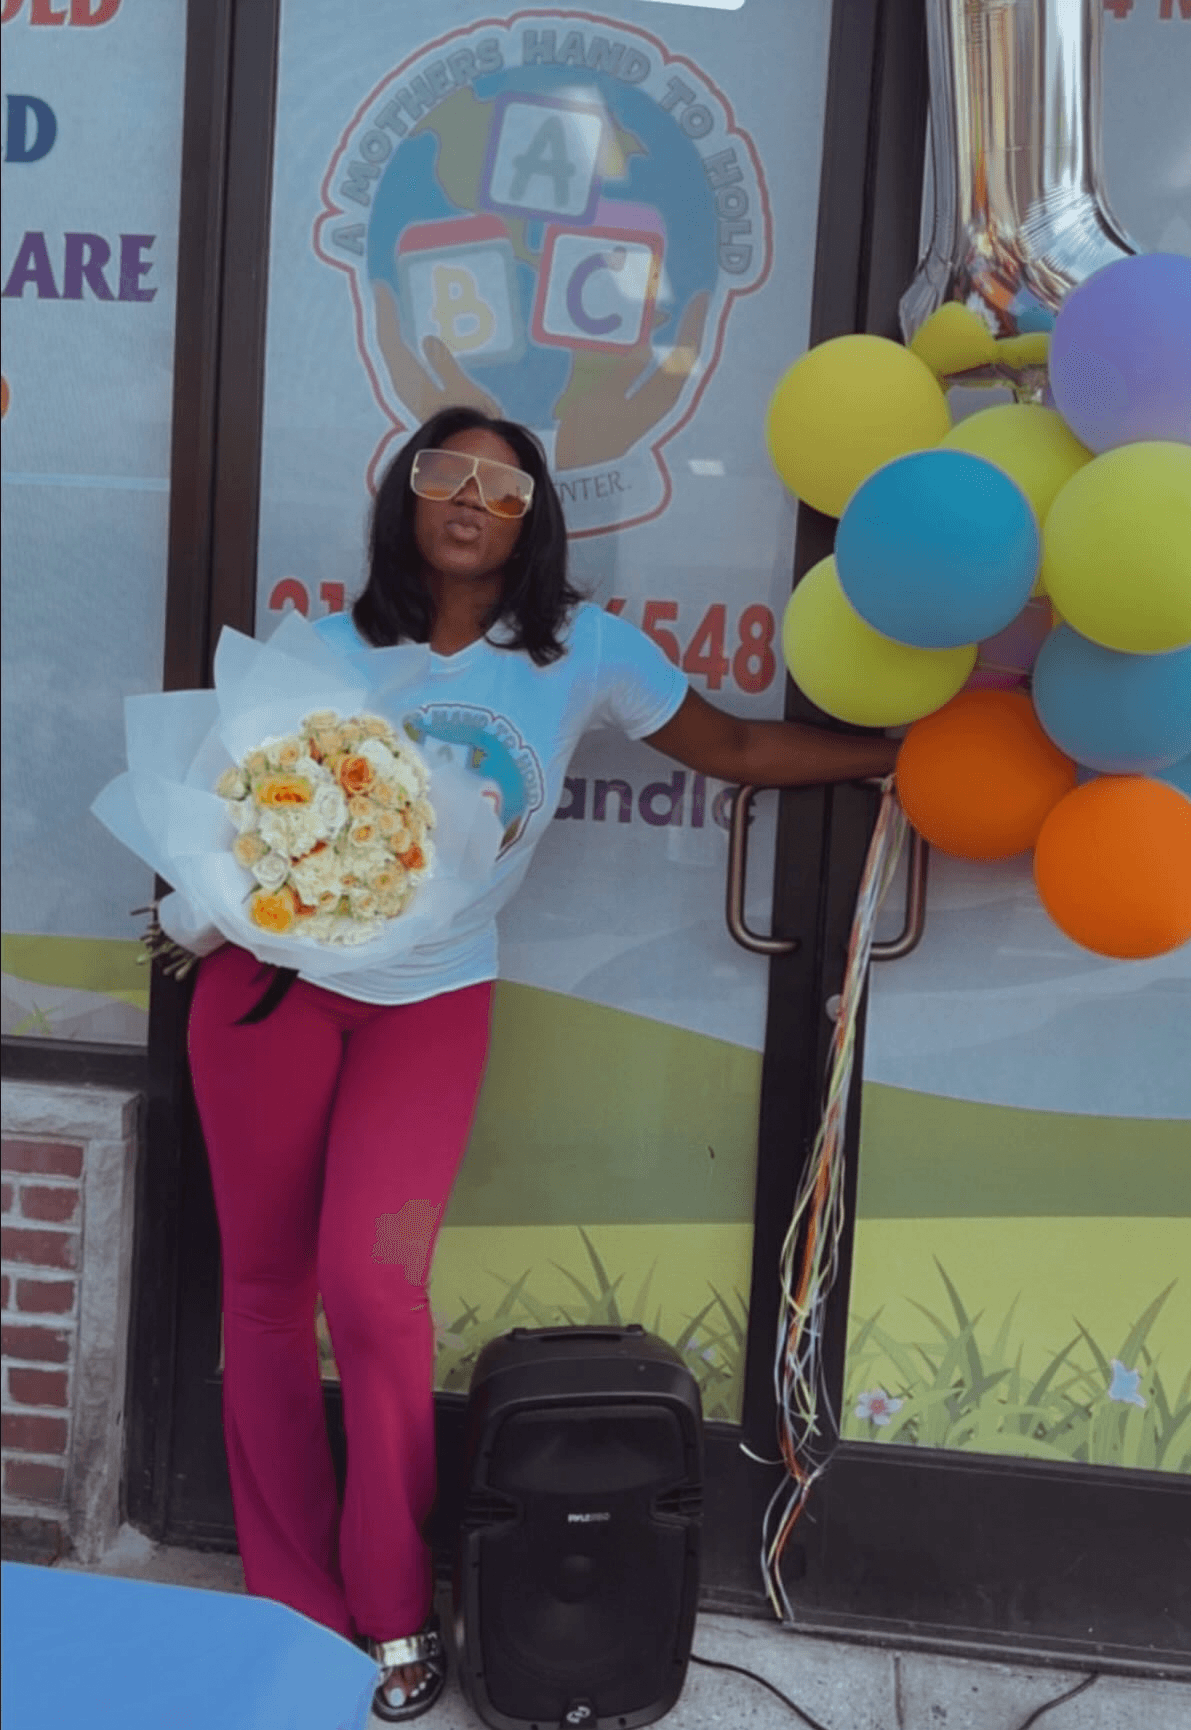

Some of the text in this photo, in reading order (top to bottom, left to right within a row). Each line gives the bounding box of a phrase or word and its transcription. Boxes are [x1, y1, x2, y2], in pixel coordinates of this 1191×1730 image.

[1, 93, 58, 164] D
[331, 29, 753, 275] A MOTHERS HAND TO HOLD
[509, 114, 576, 208] A
[1, 231, 158, 303] ARE
[432, 246, 628, 352] B C
[553, 470, 632, 503] NTER.
[604, 597, 776, 694] 548
